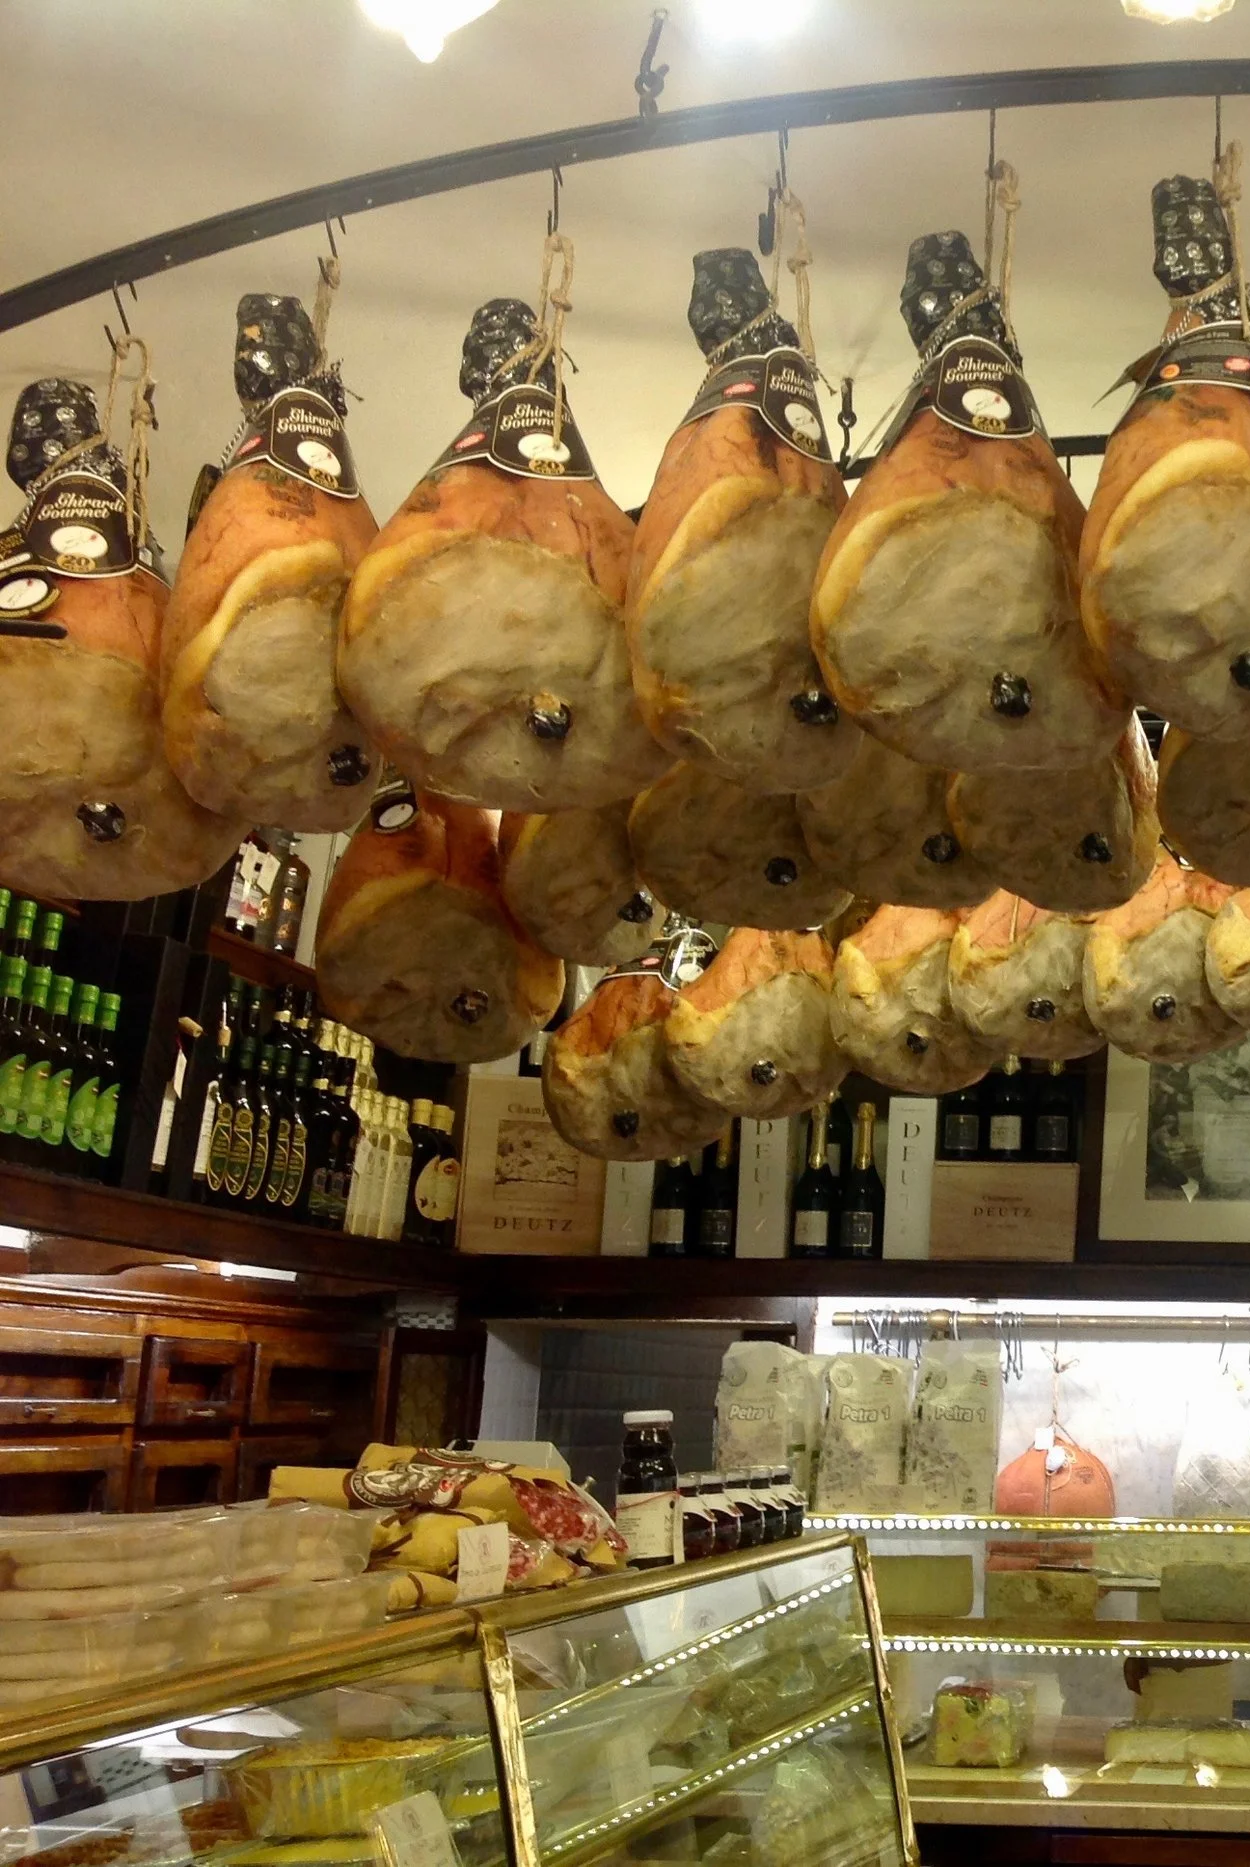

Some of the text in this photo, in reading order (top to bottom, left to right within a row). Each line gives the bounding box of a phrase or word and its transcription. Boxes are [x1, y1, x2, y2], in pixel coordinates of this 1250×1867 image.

[957, 356, 1013, 376] Ghirardi
[944, 367, 1004, 384] Gourmet
[288, 407, 340, 431] Ghirardi
[514, 403, 573, 425] Ghiradi
[276, 417, 334, 438] Gourmet
[55, 492, 125, 513] Ghirardi
[38, 503, 110, 521] Gourmet
[64, 554, 90, 567] 20
[508, 1103, 551, 1118] Champ
[973, 1207, 1034, 1219] DEUTZ
[493, 1216, 574, 1232] DEUTZ
[728, 1403, 776, 1421] Petra 1
[839, 1403, 892, 1423] Petra 1
[935, 1404, 987, 1423] Petra 1
